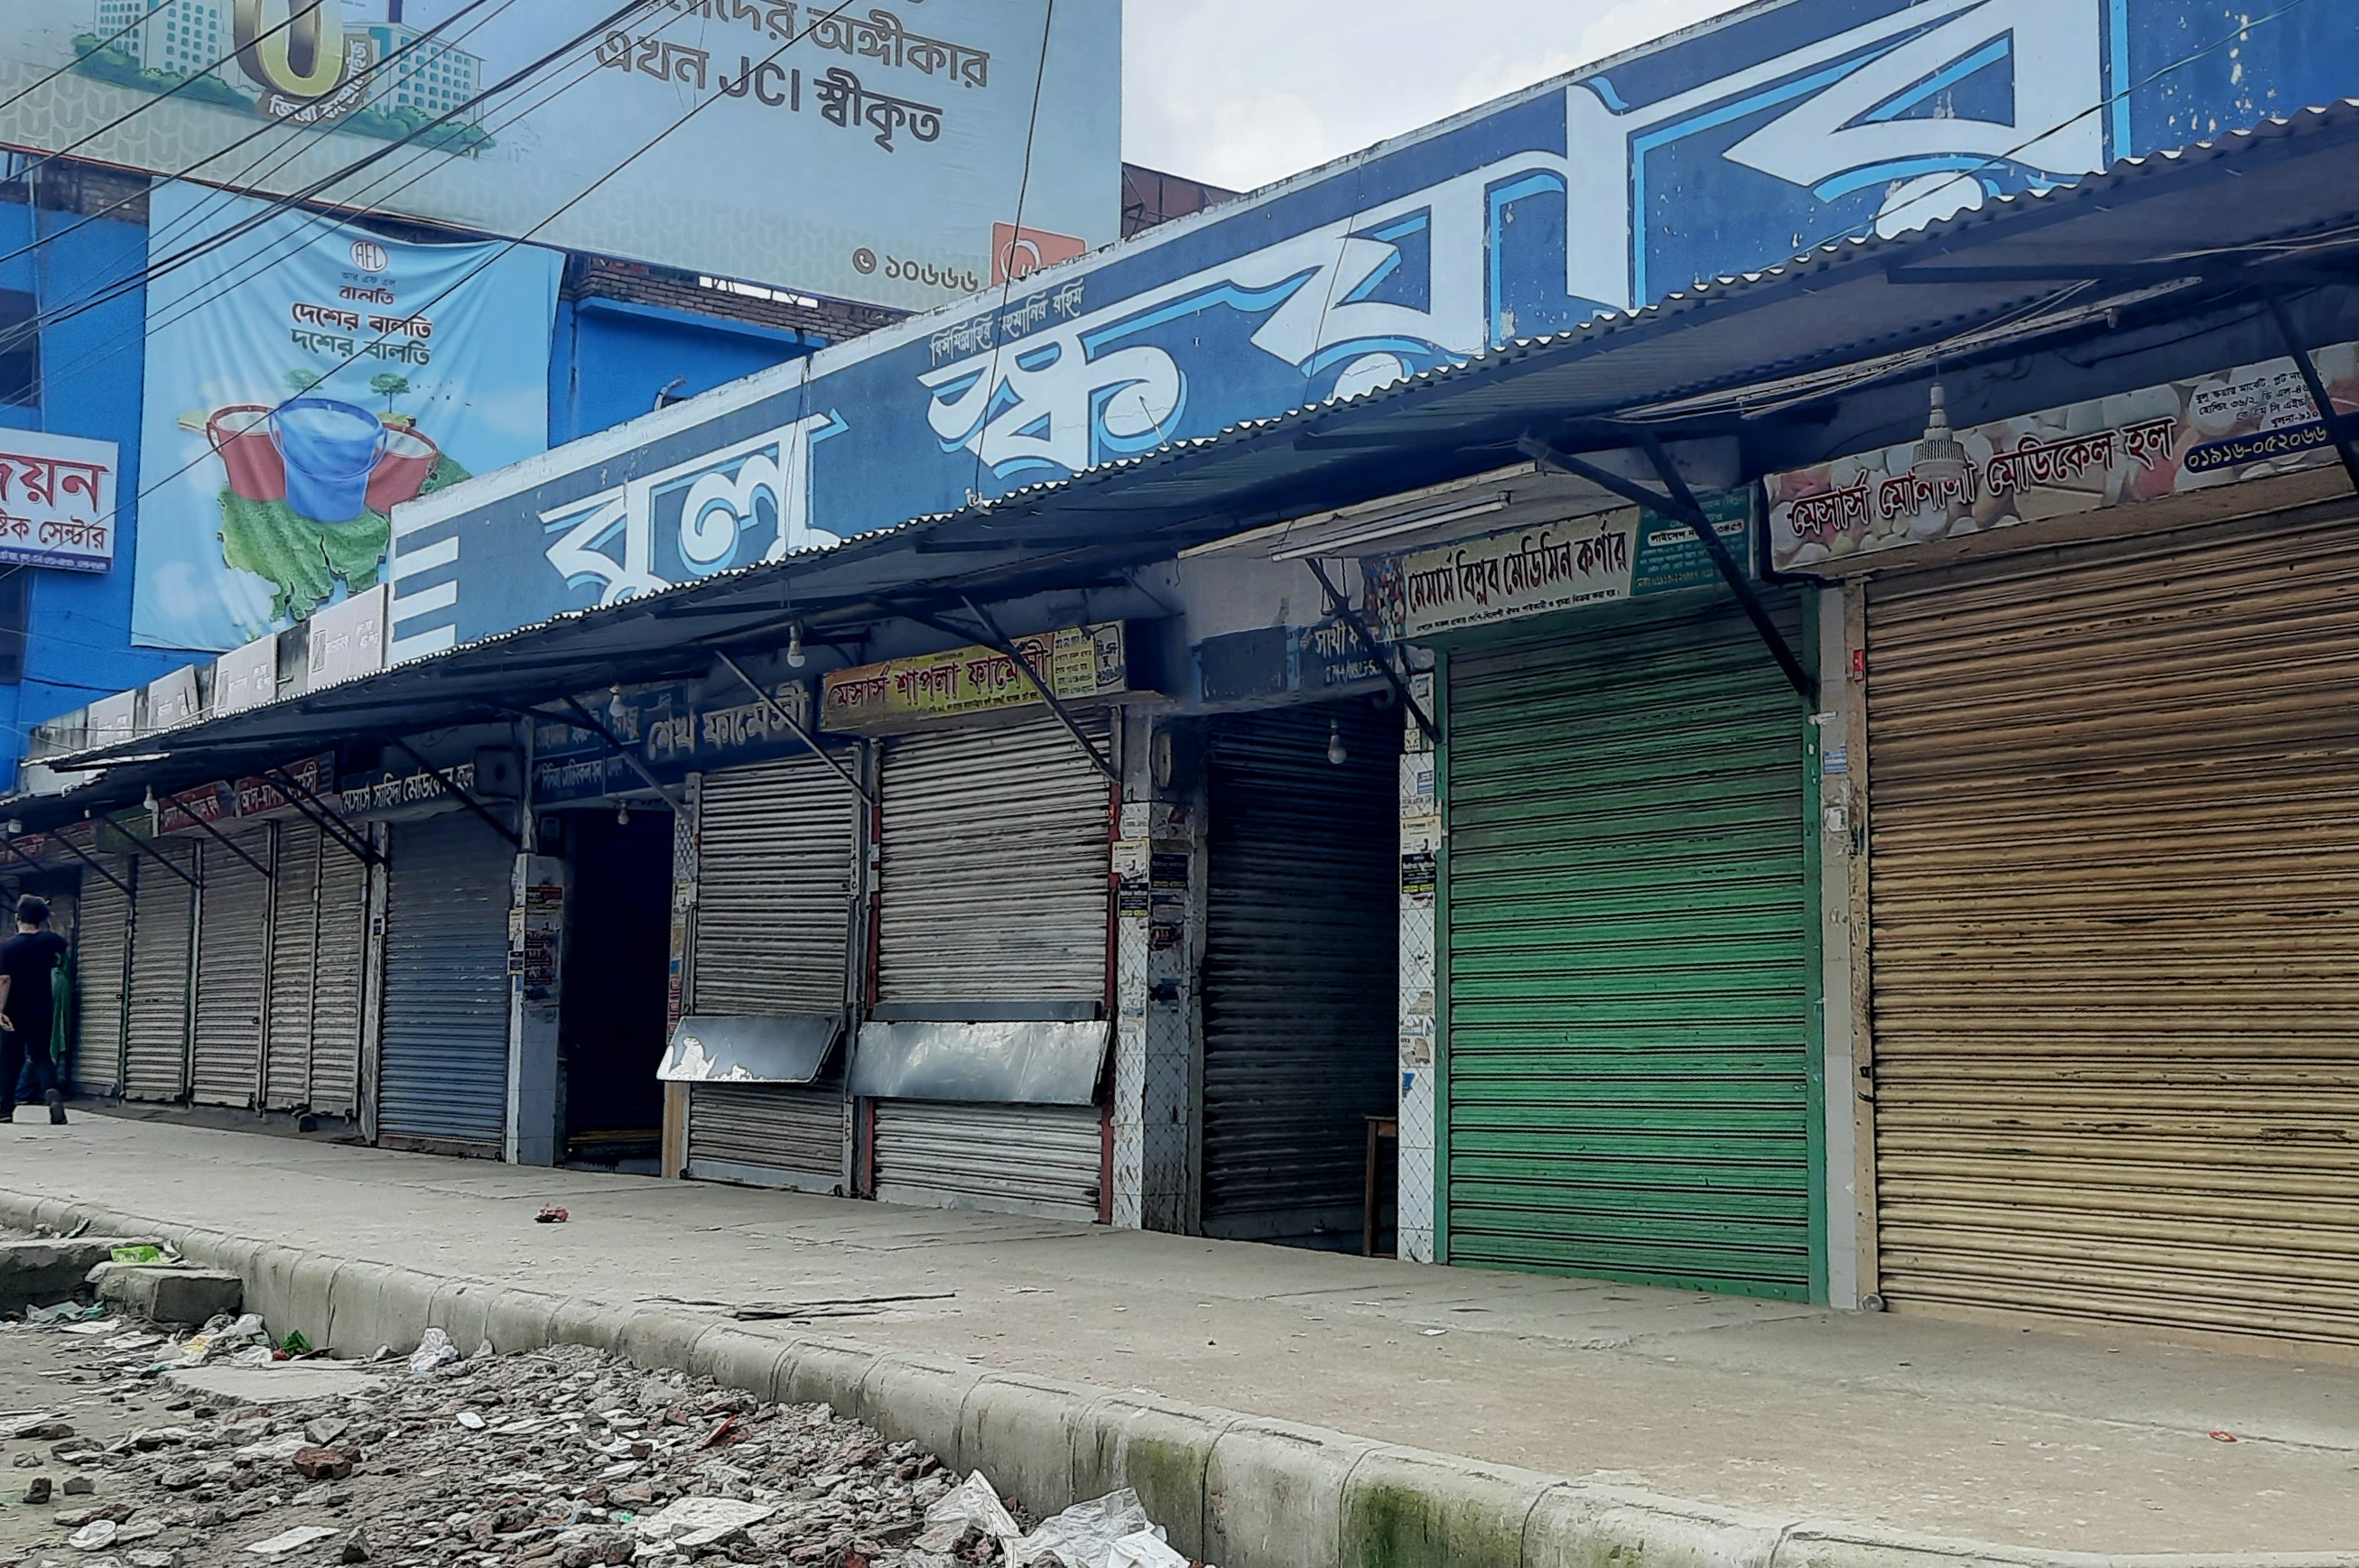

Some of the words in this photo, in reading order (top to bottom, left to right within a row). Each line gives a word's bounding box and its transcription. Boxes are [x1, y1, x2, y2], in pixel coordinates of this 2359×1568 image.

[807, 8, 990, 88] অঙ্গীকার
[595, 30, 710, 89] এখন
[720, 56, 801, 112] JCI
[813, 67, 943, 153] স্বীকৃত
[339, 284, 395, 305] বালতি
[885, 255, 980, 293] ১০৬৬৬
[1052, 278, 1086, 319] রহিম
[292, 302, 359, 331] দেশের
[367, 314, 432, 339] বালতি
[291, 329, 355, 358] দশের
[363, 339, 432, 366] বালতি
[2187, 426, 2327, 469] ০১৯১৬-০৫২০৬৬
[1791, 469, 1871, 539] মেসার্স
[1984, 431, 2117, 498] মেডিকেল
[2122, 415, 2178, 473] হল
[39, 515, 107, 550] সেন্টার
[1408, 550, 1456, 614] মেসার্স
[1455, 545, 1501, 608] বিপ্লব
[1503, 529, 1572, 596] মেডিসিন
[828, 664, 890, 714] মেসার্স
[894, 662, 961, 706] শাপলা
